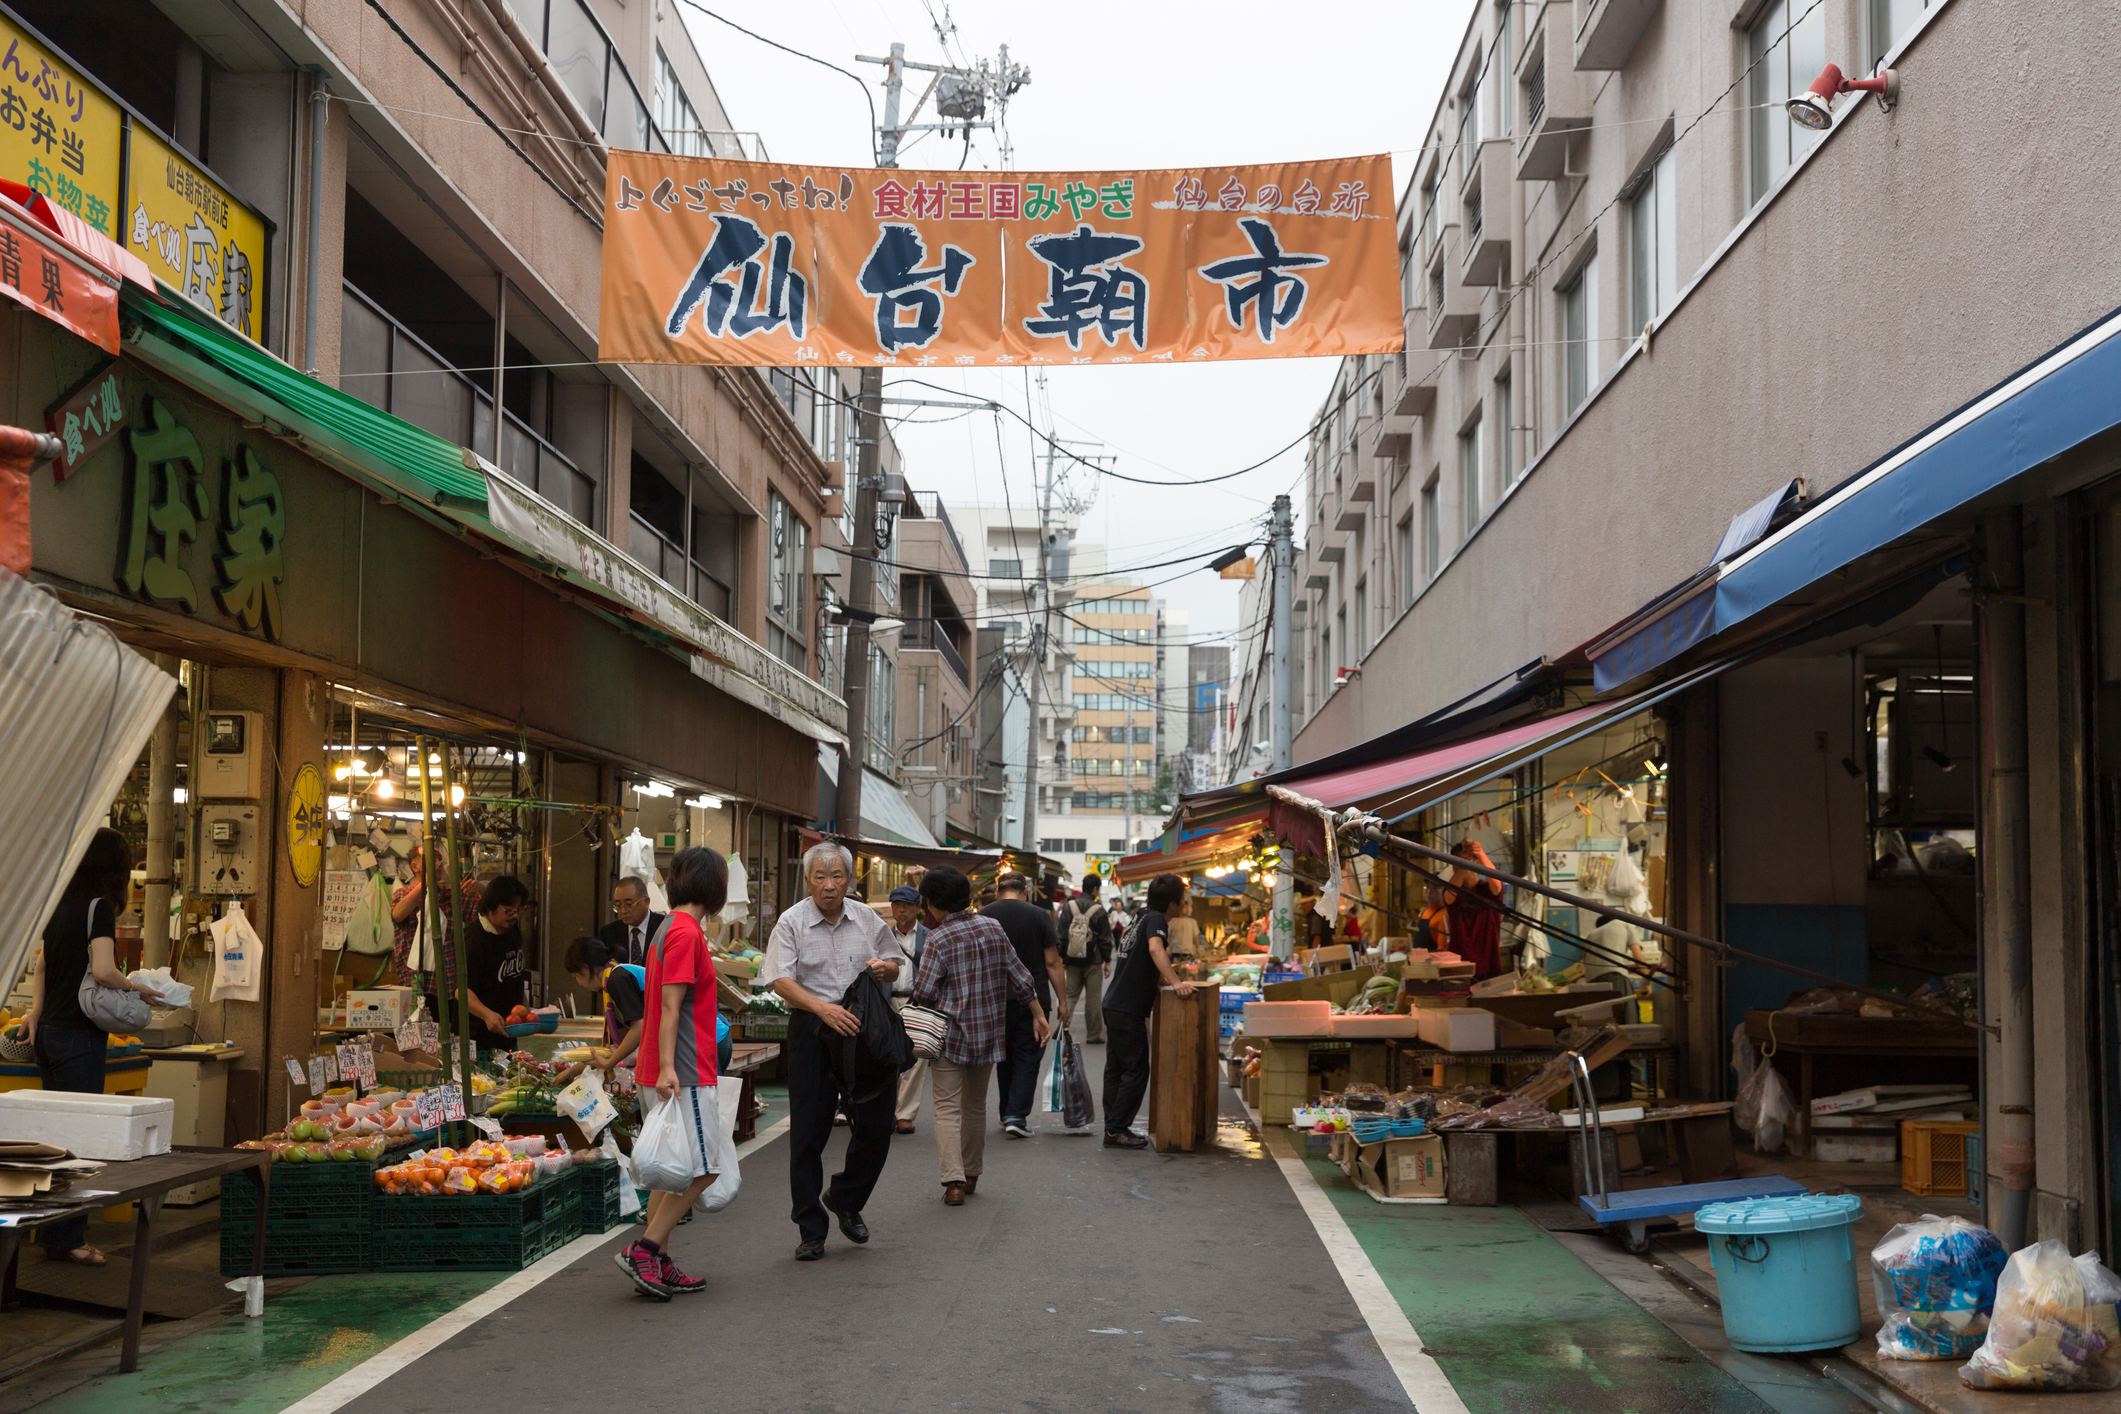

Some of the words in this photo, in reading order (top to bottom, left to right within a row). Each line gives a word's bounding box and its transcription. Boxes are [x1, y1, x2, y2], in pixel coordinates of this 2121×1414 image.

[2, 38, 84, 122] んぶり
[0, 84, 84, 175] お弁当
[27, 157, 110, 236] お惣菜
[166, 155, 229, 231] 仙台朝市駅前店
[872, 178, 1134, 219] 食材王国みやぎ
[1172, 174, 1370, 223] 仙台の台所
[132, 202, 182, 273] 食べ処
[665, 211, 1330, 353] 仙台朝市
[62, 373, 123, 467] 食べ処
[1100, 862, 1110, 875] P
